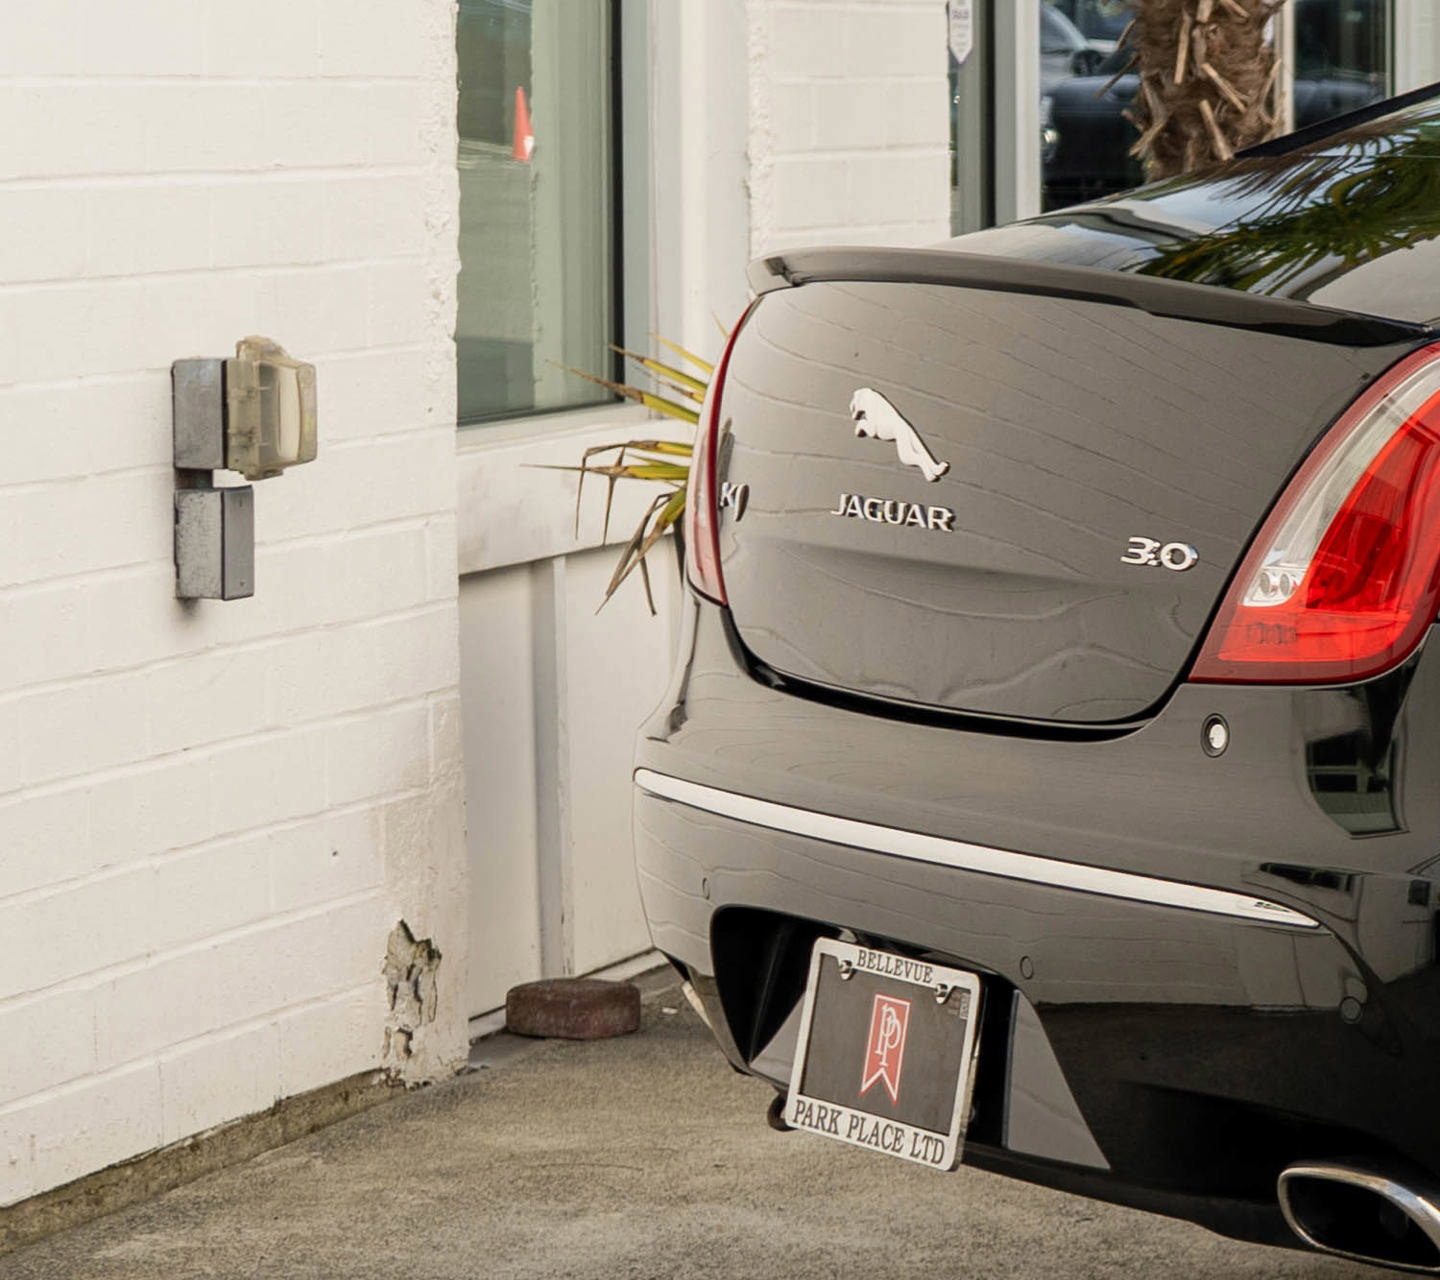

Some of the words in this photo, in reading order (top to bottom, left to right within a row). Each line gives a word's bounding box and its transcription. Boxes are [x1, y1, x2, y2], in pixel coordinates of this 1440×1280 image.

[831, 493, 955, 532] JAGUAR
[856, 950, 934, 984] BELLEVUE
[793, 1100, 843, 1136] PARK
[847, 1114, 905, 1153] PLACE
[909, 1132, 946, 1164] LTD
